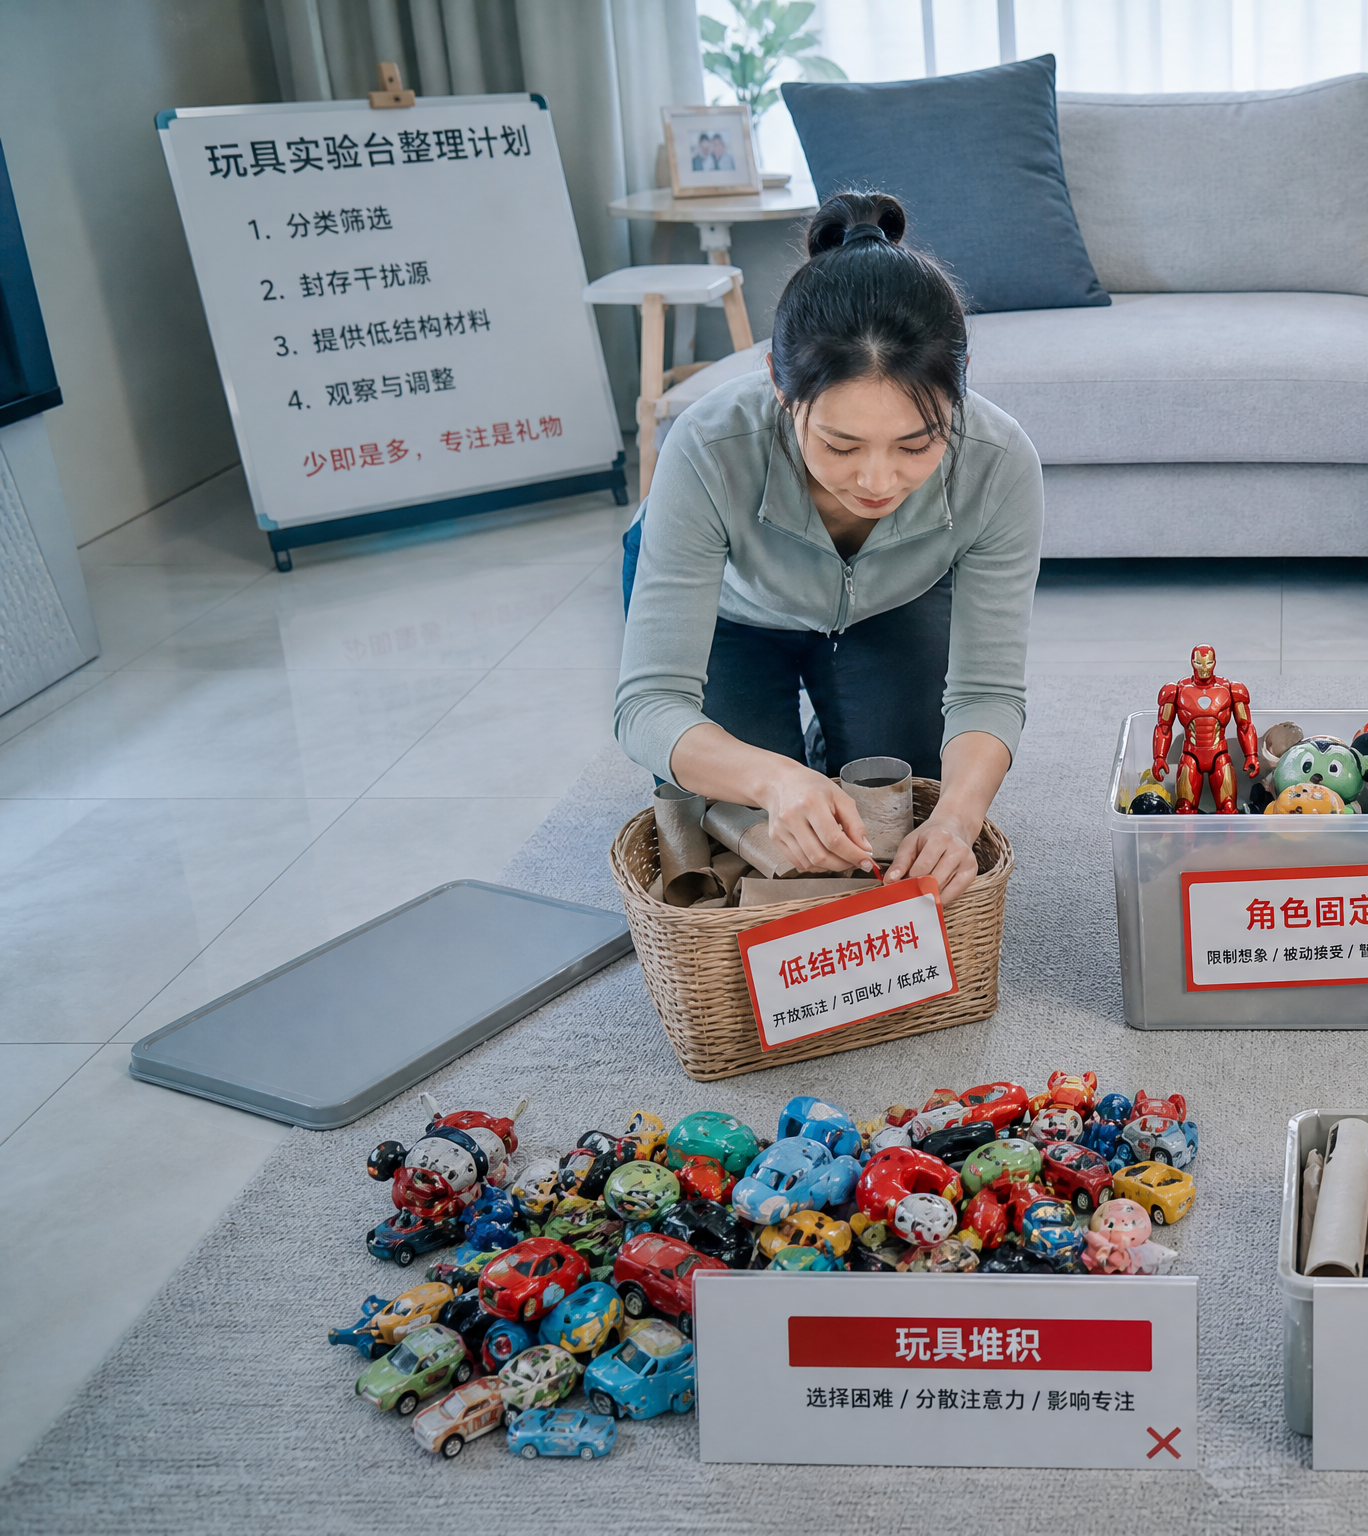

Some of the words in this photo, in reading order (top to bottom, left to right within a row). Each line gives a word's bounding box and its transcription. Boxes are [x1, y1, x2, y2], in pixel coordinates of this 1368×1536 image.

[204, 124, 532, 180] 玩具实验台整理计划
[247, 219, 271, 241] 1.
[286, 205, 393, 239] 分类筛选
[259, 279, 285, 302] 2.
[299, 260, 432, 299] 封存干扰源
[273, 335, 298, 357] 3.
[311, 308, 491, 354] 提供低结构材料
[287, 389, 311, 411] 4.
[324, 366, 456, 407] 观察与调整
[778, 920, 920, 990] 低结构材料
[1206, 947, 1268, 966] 限制想象
[1283, 943, 1344, 962] 被动接受
[840, 981, 884, 1006] 可回收
[895, 1326, 1042, 1363] 玩具堆积
[806, 1386, 894, 1410] 选择困难
[915, 1388, 1025, 1411] 分散注意力
[1047, 1389, 1136, 1412] 影响专注
